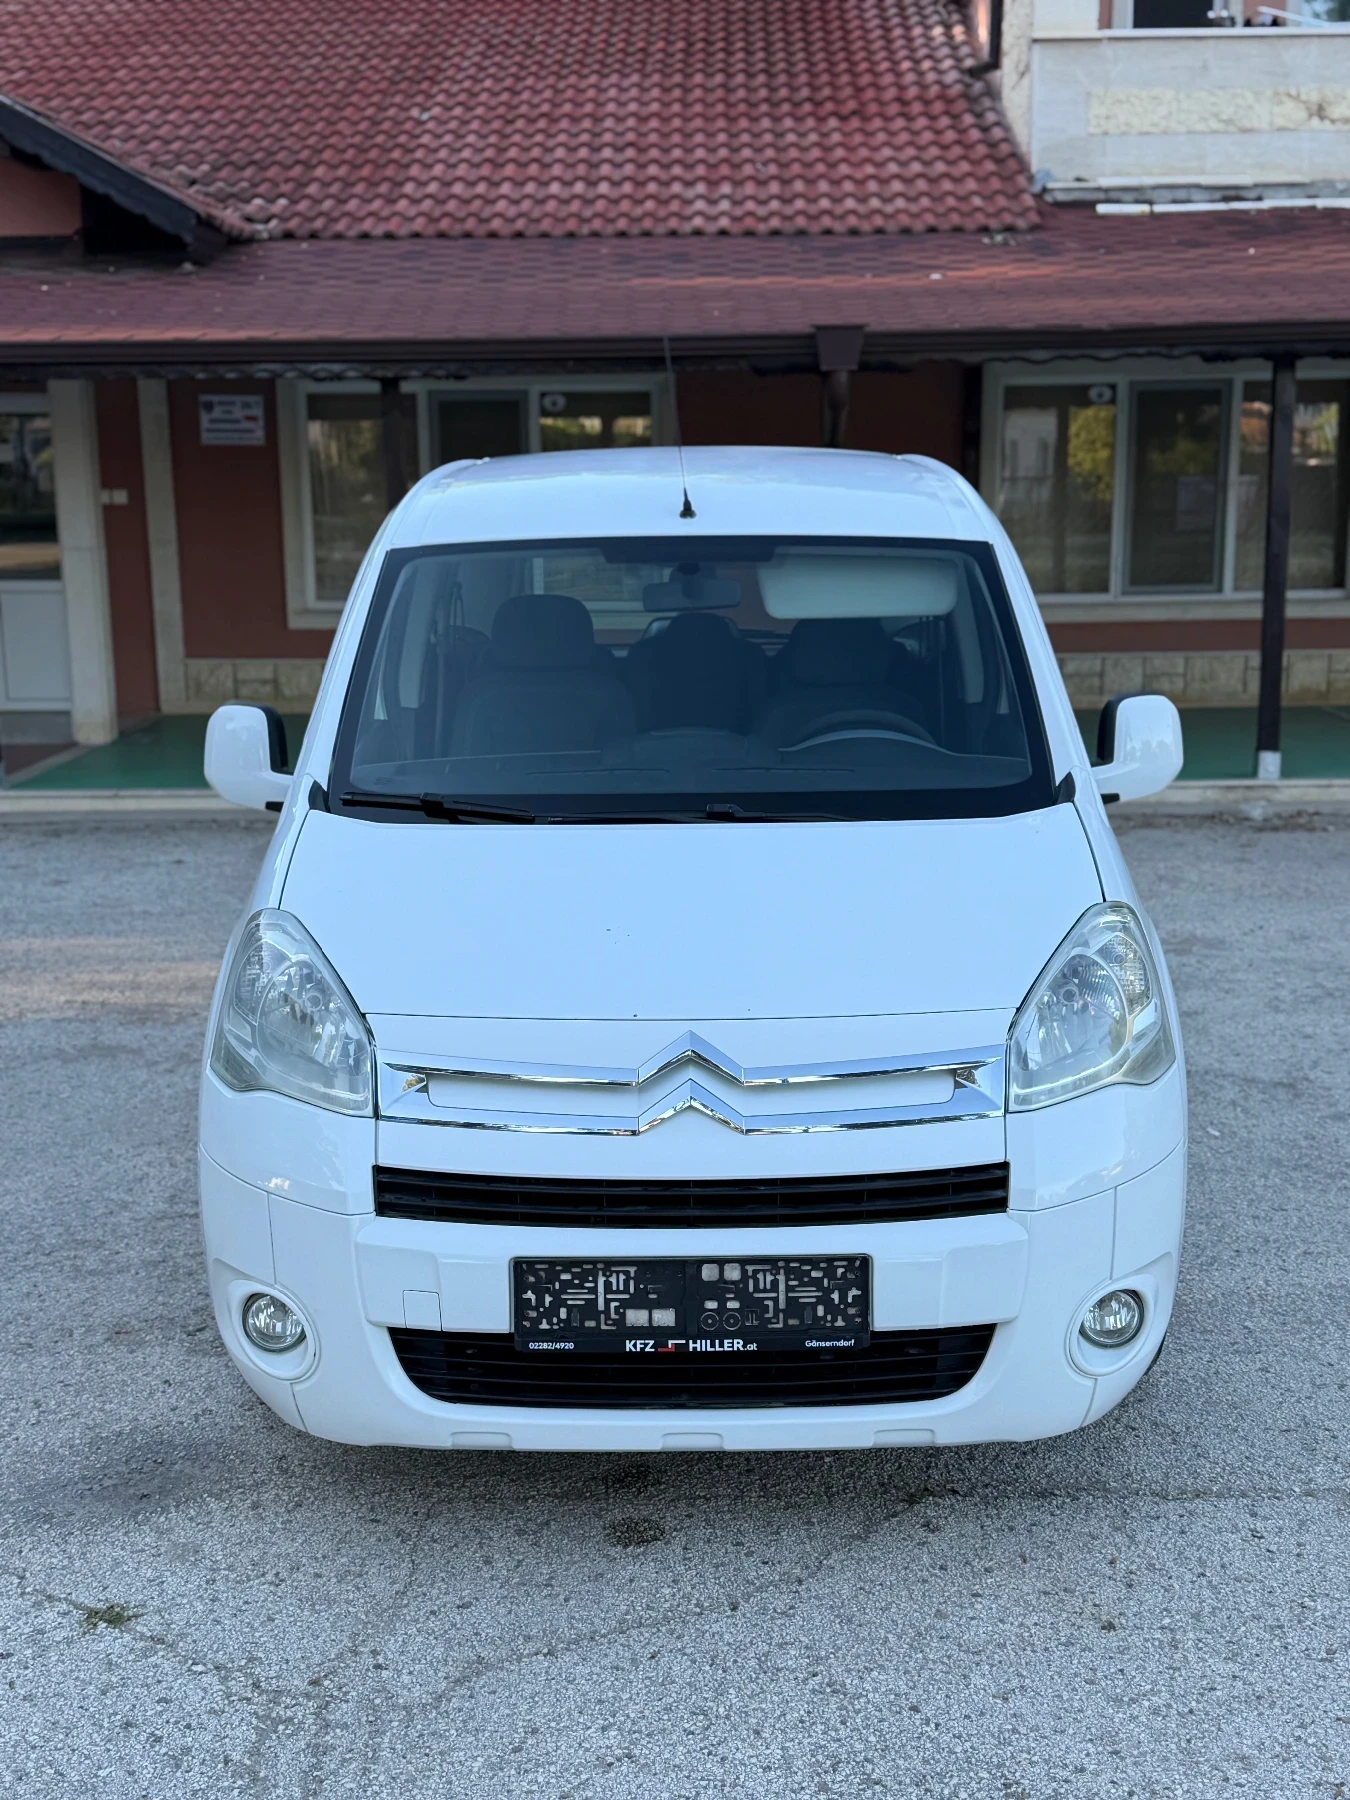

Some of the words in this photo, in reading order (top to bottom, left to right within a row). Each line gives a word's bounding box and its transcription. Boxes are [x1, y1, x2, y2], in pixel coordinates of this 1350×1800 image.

[528, 1341, 575, 1351] 02282/4920
[625, 1339, 655, 1352] KFZ
[688, 1339, 758, 1352] HILLER.at
[805, 1338, 855, 1348] Gänserndorf
